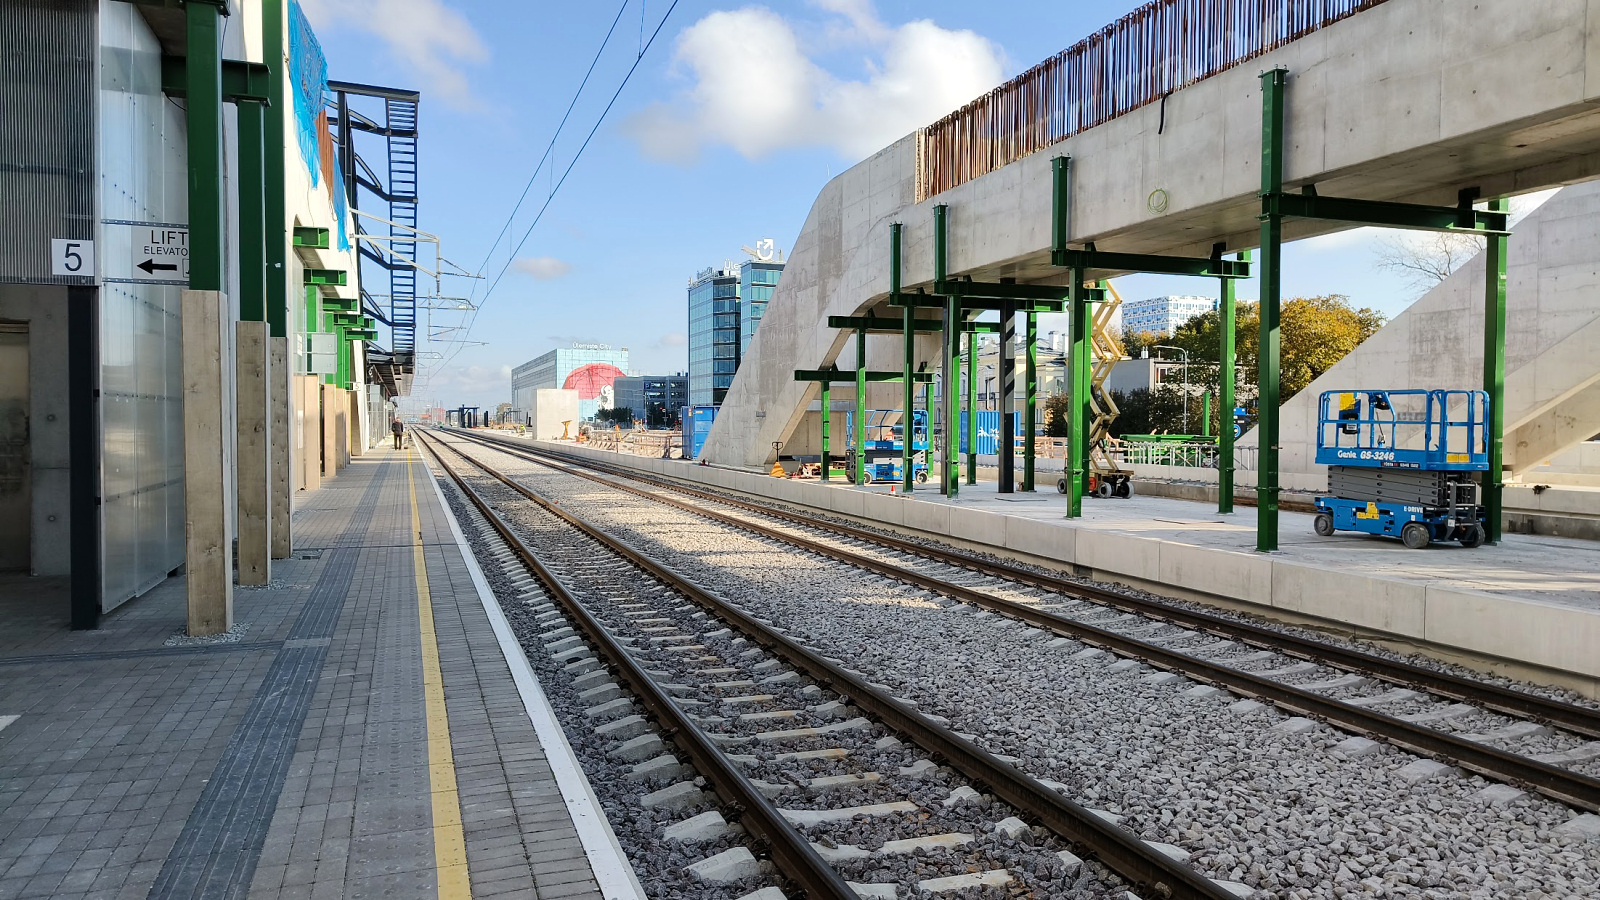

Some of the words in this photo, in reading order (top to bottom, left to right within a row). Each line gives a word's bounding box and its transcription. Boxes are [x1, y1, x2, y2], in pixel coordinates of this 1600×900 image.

[151, 230, 188, 245] LIFT
[65, 243, 82, 271] 5
[599, 343, 612, 351] City
[1337, 449, 1357, 459] Genie
[1360, 450, 1395, 461] GS-3246
